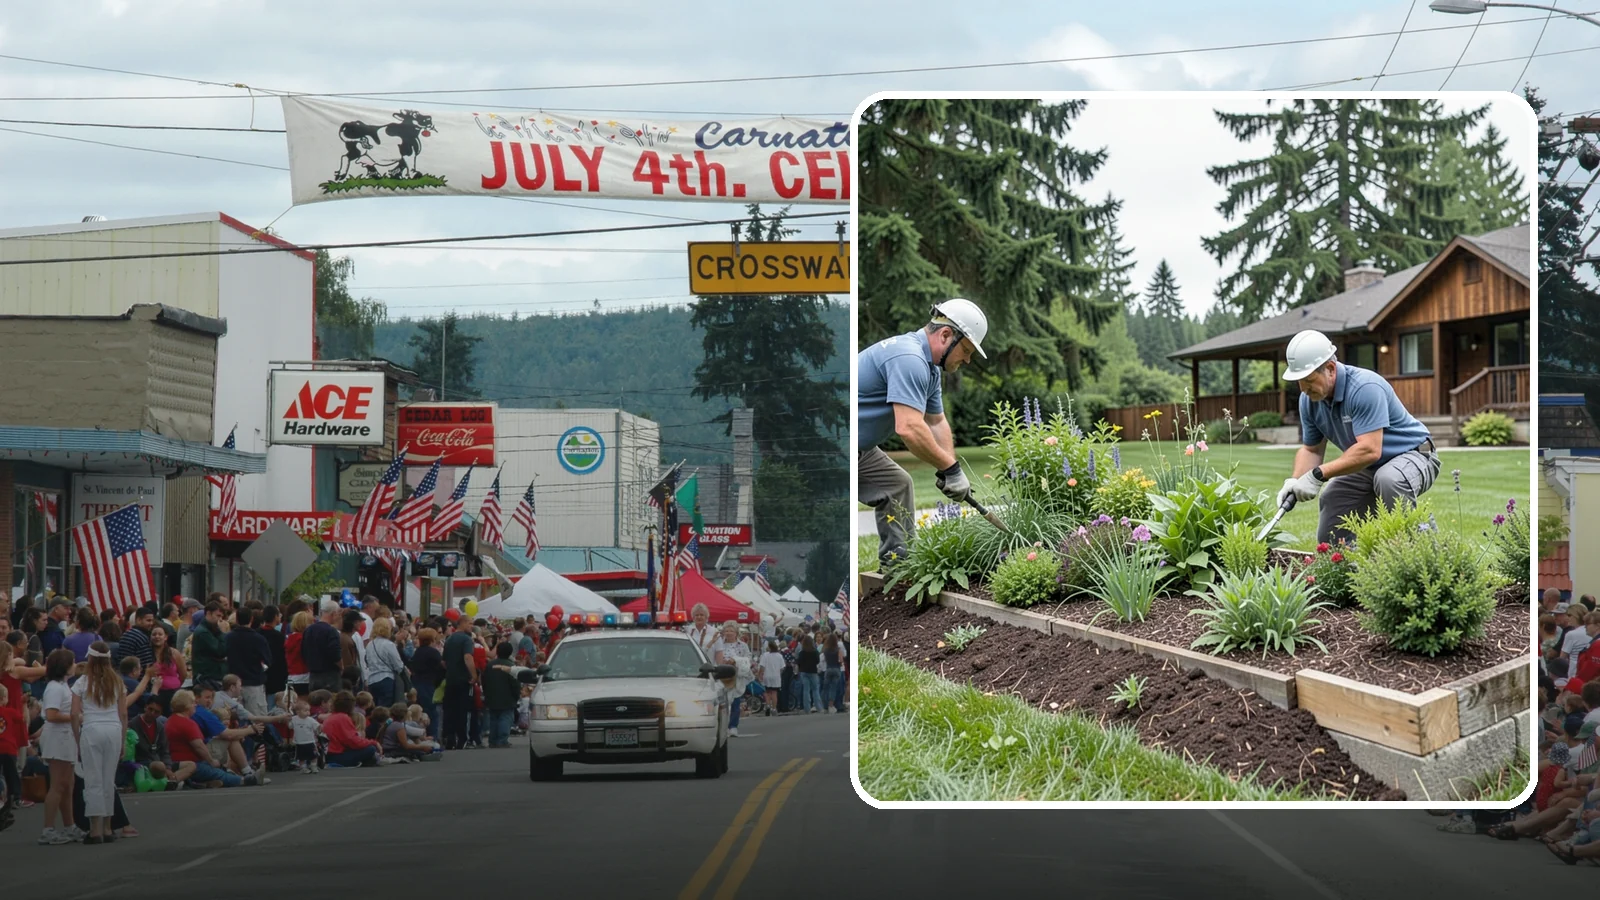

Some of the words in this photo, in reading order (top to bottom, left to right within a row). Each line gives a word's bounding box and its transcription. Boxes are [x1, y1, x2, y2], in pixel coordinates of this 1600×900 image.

[694, 121, 850, 150] Carnat
[481, 141, 605, 193] JULY
[632, 150, 746, 197] 4th.
[697, 254, 850, 281] CROSSWA
[283, 380, 373, 420] ACE
[405, 408, 453, 422] CEDAR
[461, 408, 485, 422] LOG
[283, 421, 371, 436] Hardware
[416, 428, 476, 447] Coca-Cola
[353, 467, 384, 481] Simpl
[96, 485, 124, 494] Vincent
[126, 486, 136, 495] de
[138, 486, 155, 495] Paul
[688, 526, 742, 535] CRNATION
[699, 535, 730, 543] GLASS
